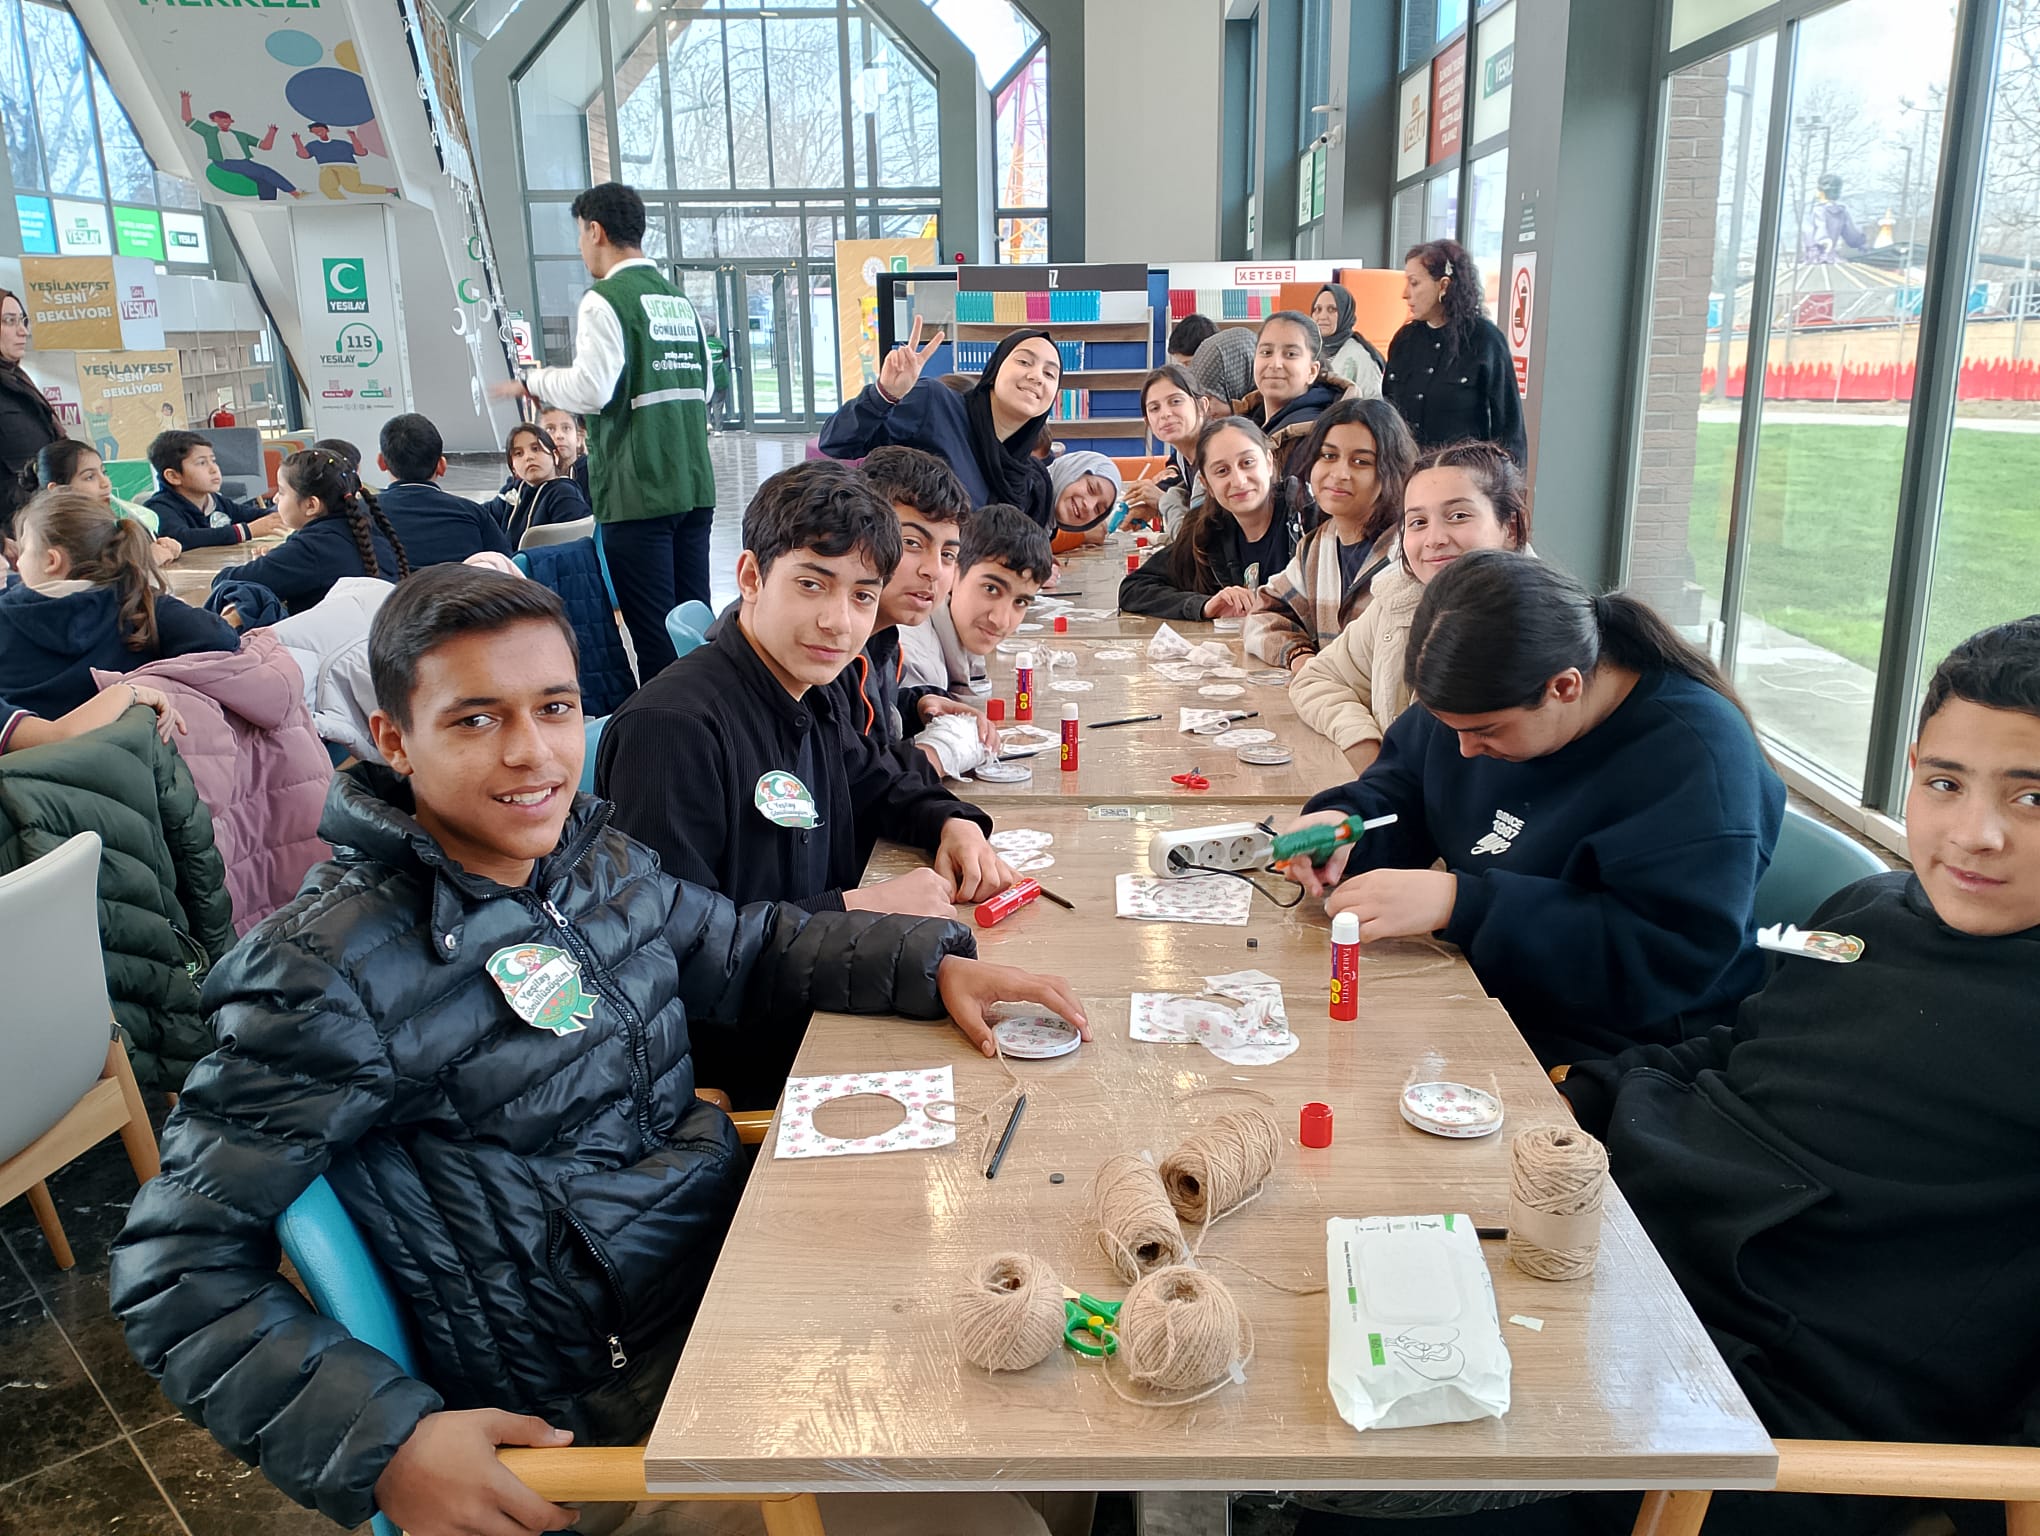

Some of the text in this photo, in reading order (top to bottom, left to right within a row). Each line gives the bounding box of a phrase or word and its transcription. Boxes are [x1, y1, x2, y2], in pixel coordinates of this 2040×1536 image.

[1239, 271, 1291, 281] KETEBE
[36, 306, 112, 322] BEKLİYOR!
[347, 335, 373, 348] 115
[103, 383, 163, 398] BEKLİYOR!
[1496, 809, 1526, 831] SINCE
[1493, 819, 1520, 841] 1997
